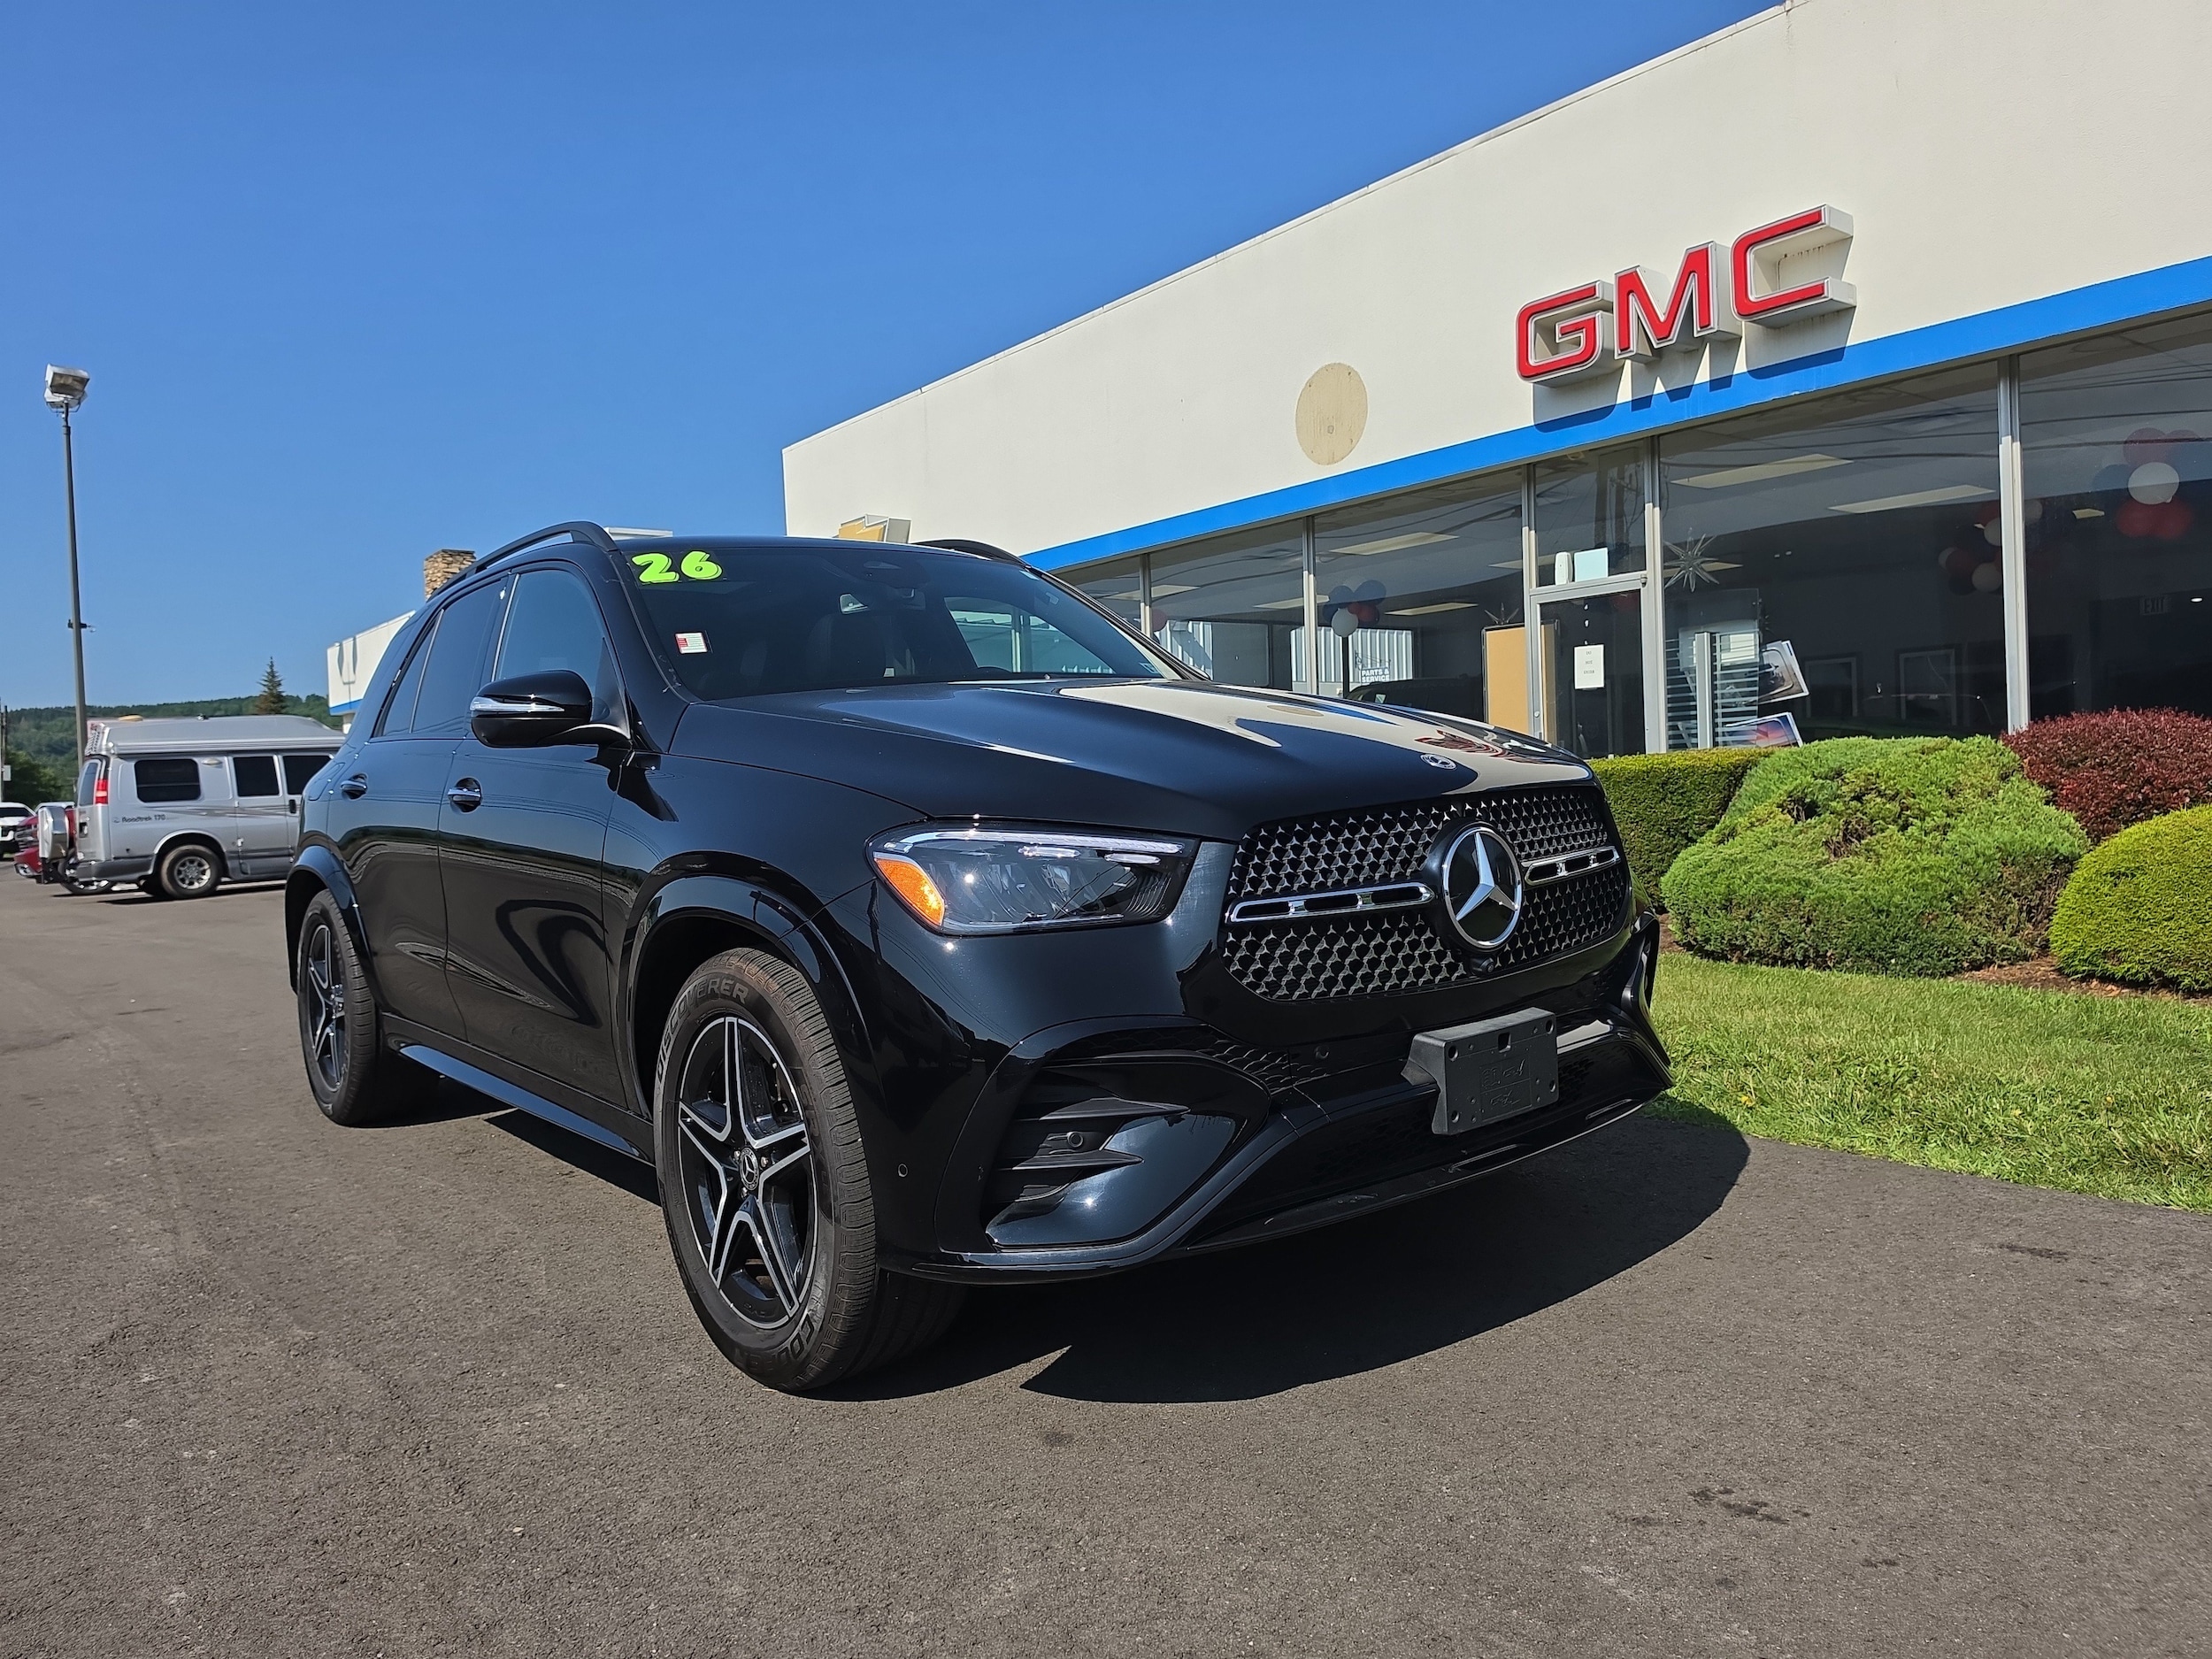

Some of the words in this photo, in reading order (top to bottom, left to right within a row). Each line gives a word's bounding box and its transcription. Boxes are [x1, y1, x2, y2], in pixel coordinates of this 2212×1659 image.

[1517, 204, 1856, 387] GMC
[632, 550, 723, 584] 26
[2144, 597, 2165, 614] EXIT
[1362, 674, 1390, 683] SERVICE
[657, 977, 749, 1084] DISCOVERER
